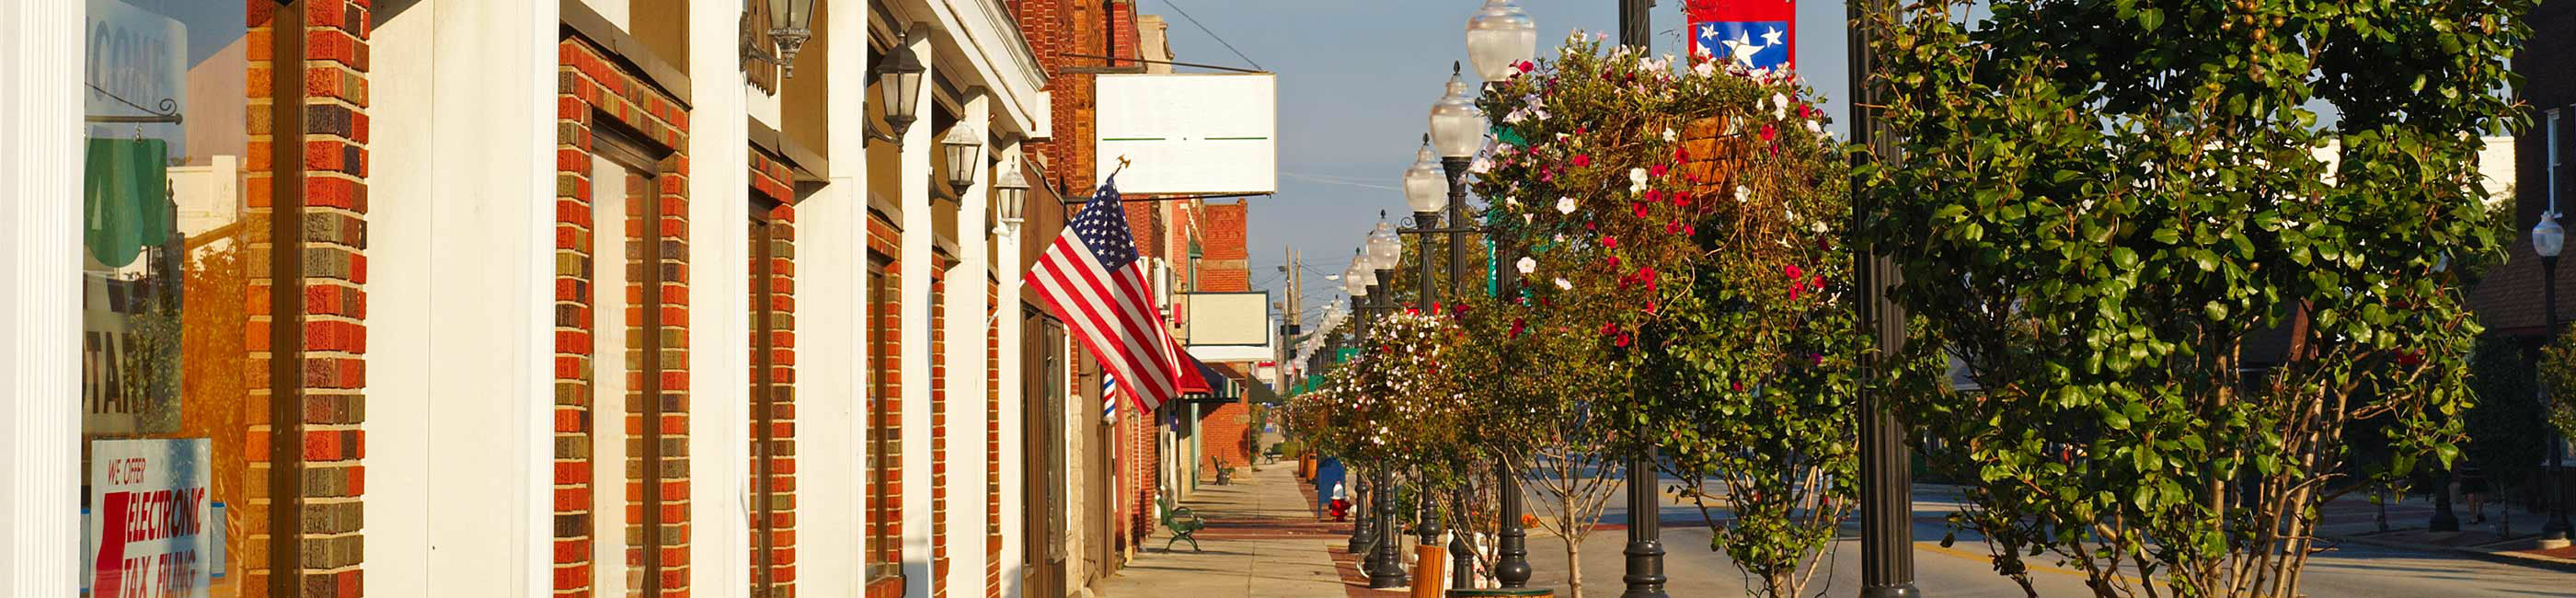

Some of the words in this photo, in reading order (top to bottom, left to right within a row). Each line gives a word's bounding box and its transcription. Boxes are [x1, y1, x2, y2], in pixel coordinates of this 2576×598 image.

[108, 459, 121, 485] WE
[123, 457, 146, 485] OFFER
[127, 487, 204, 543] ELECTRONIC
[123, 556, 151, 598] TAX
[156, 549, 196, 598] FILING
